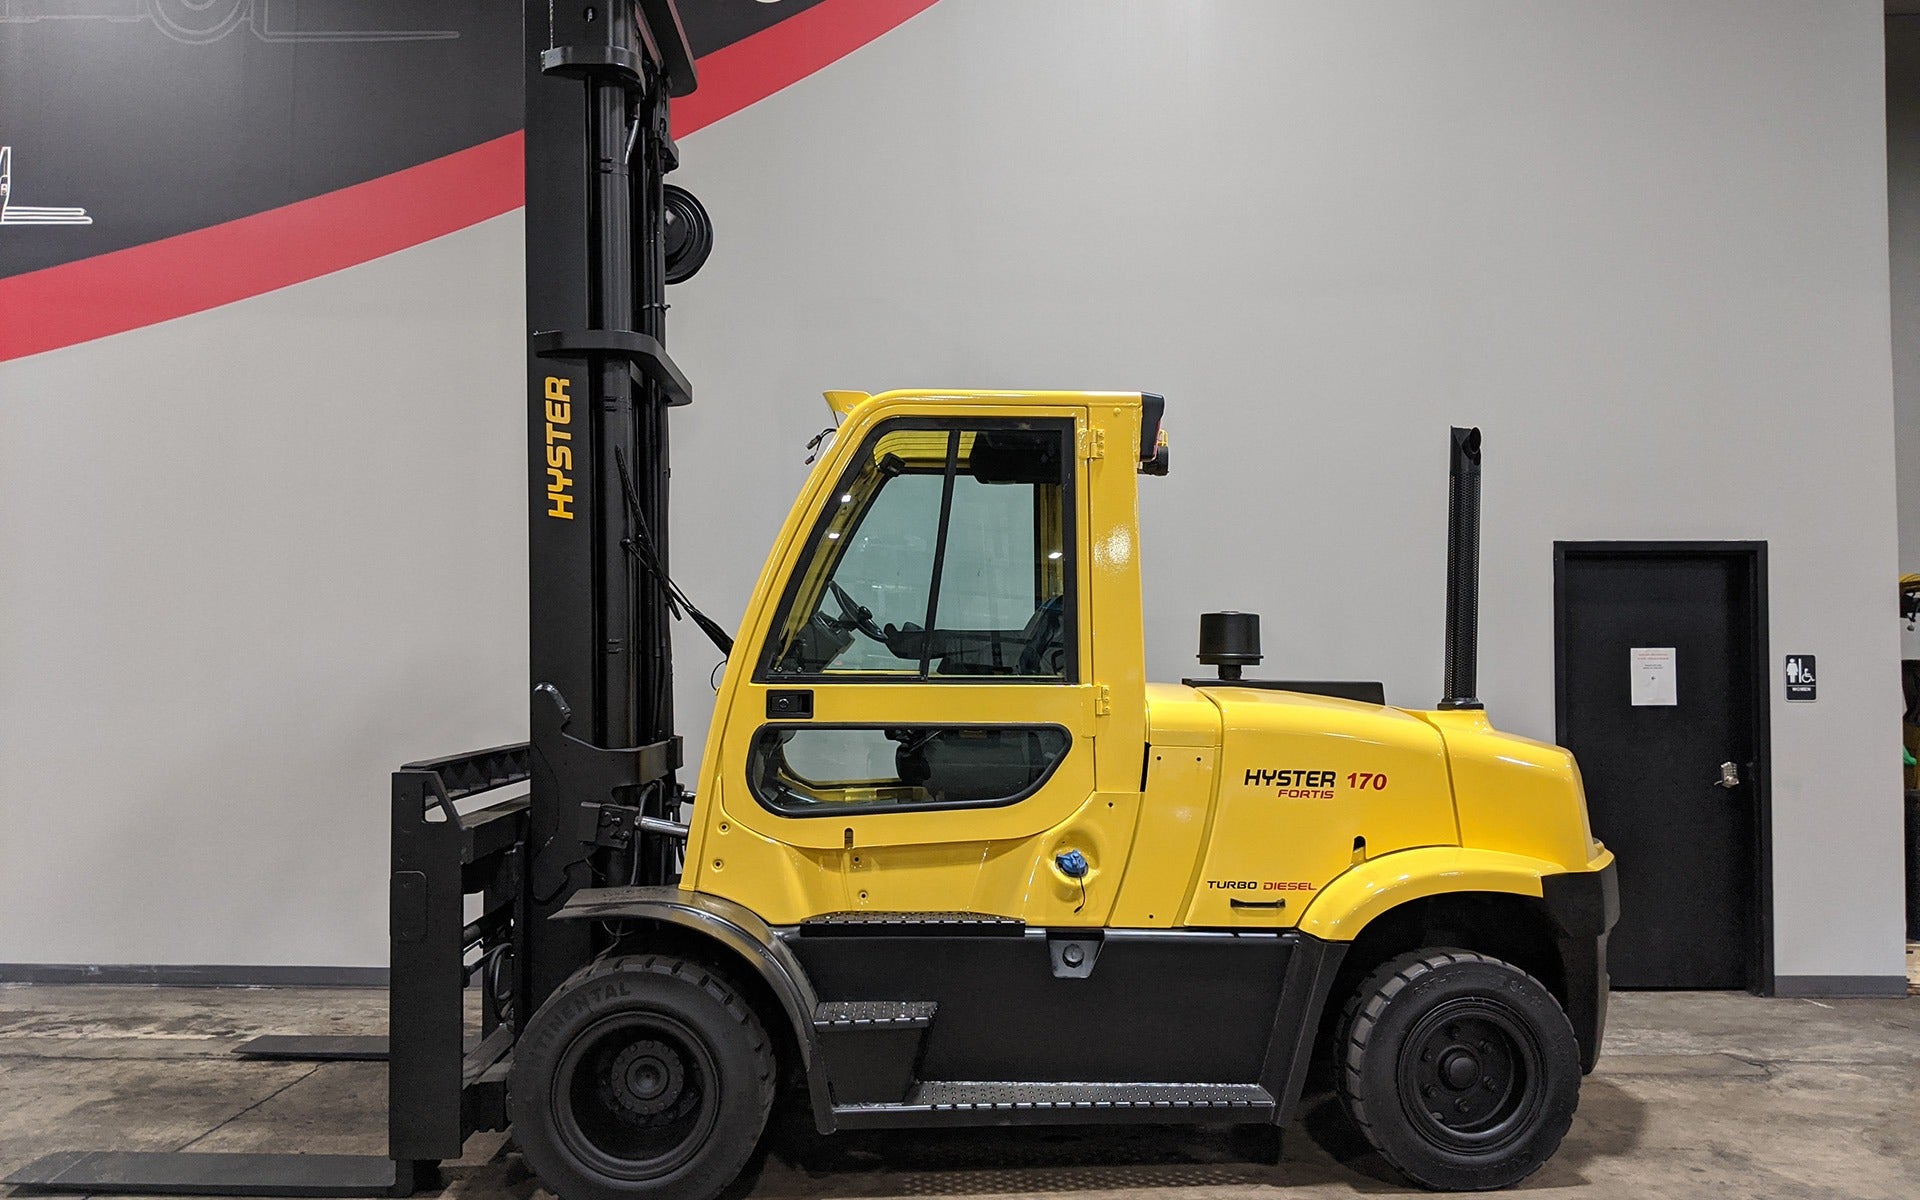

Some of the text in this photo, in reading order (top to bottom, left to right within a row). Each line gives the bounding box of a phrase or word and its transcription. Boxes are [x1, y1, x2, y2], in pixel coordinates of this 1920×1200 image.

[545, 376, 574, 520] HYSTER
[1244, 769, 1387, 790] HYSTER 170
[1278, 789, 1334, 799] FORTIS
[1207, 881, 1317, 890] TURBO DIESEL
